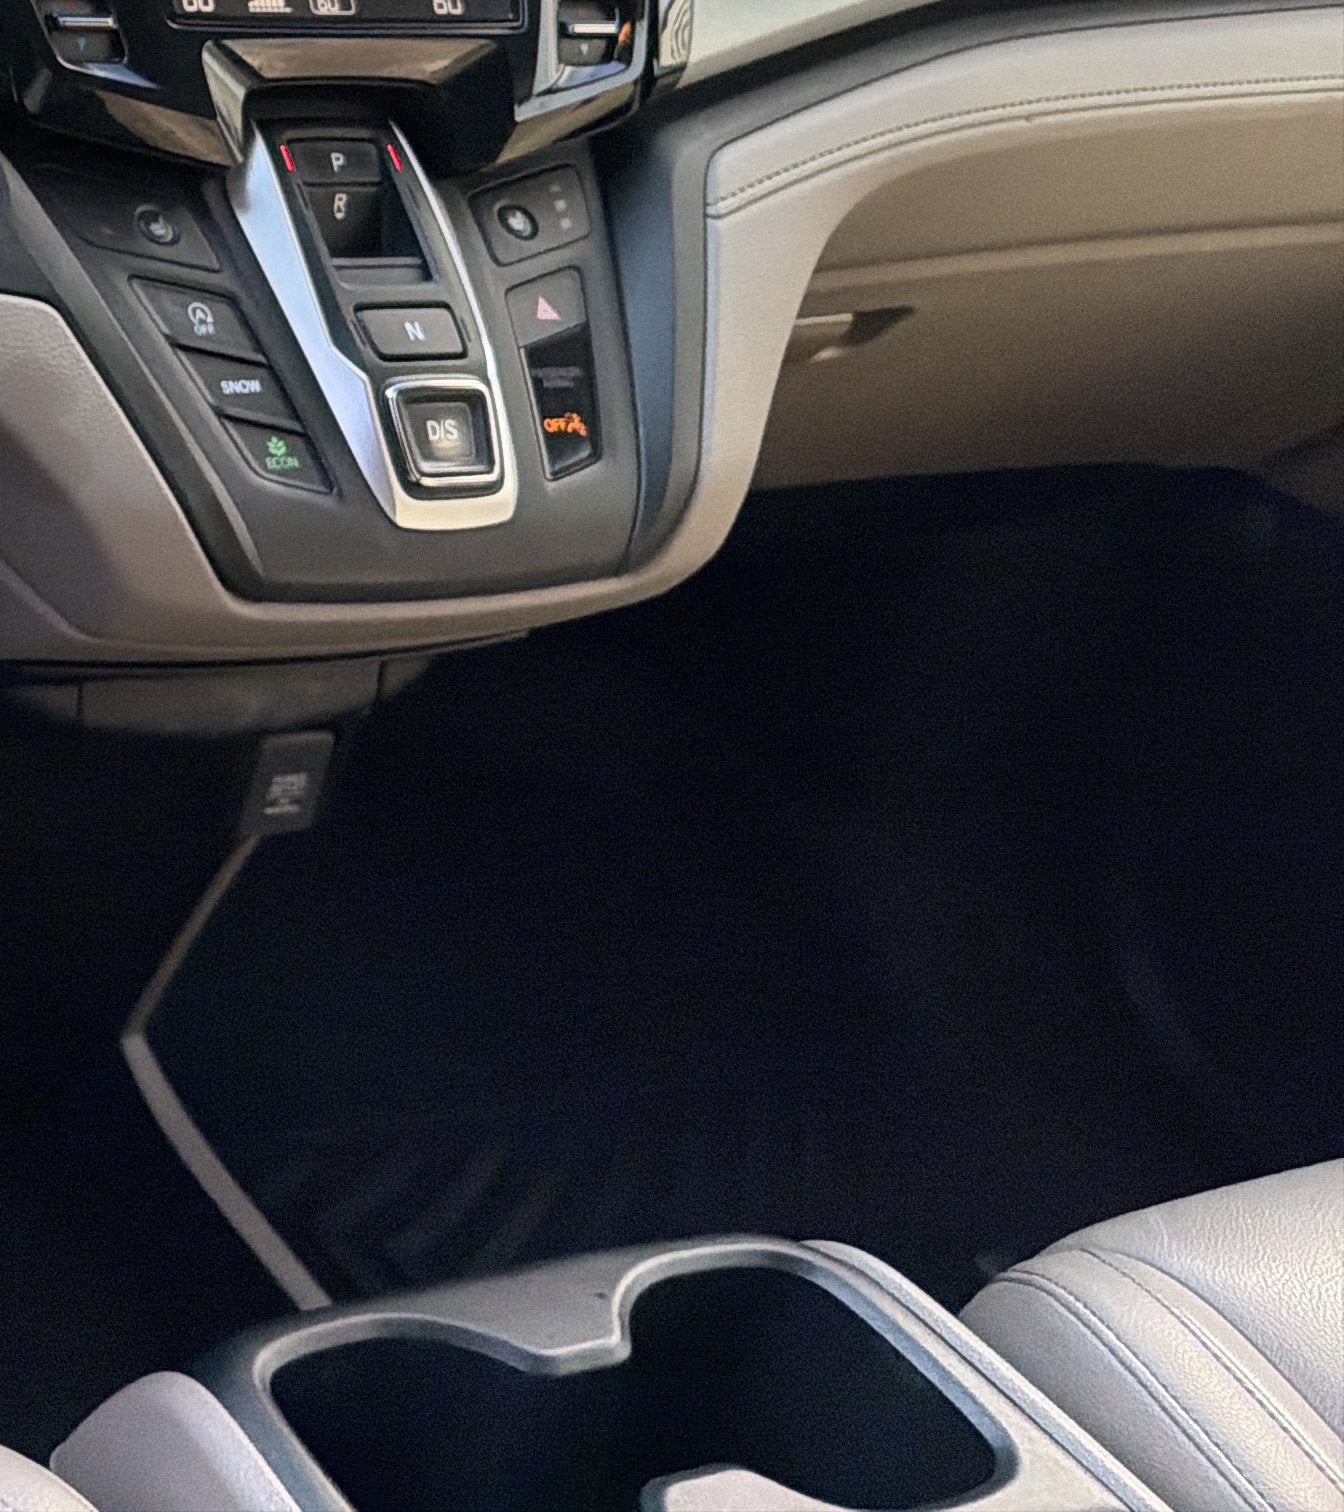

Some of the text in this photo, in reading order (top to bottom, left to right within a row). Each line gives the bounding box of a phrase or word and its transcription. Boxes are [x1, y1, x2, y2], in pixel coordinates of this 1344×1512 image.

[330, 151, 345, 172] P
[193, 323, 215, 336] OFF
[404, 321, 426, 342] N
[221, 379, 262, 395] SNOW
[426, 418, 459, 441] D/S
[265, 456, 300, 470] ECON
